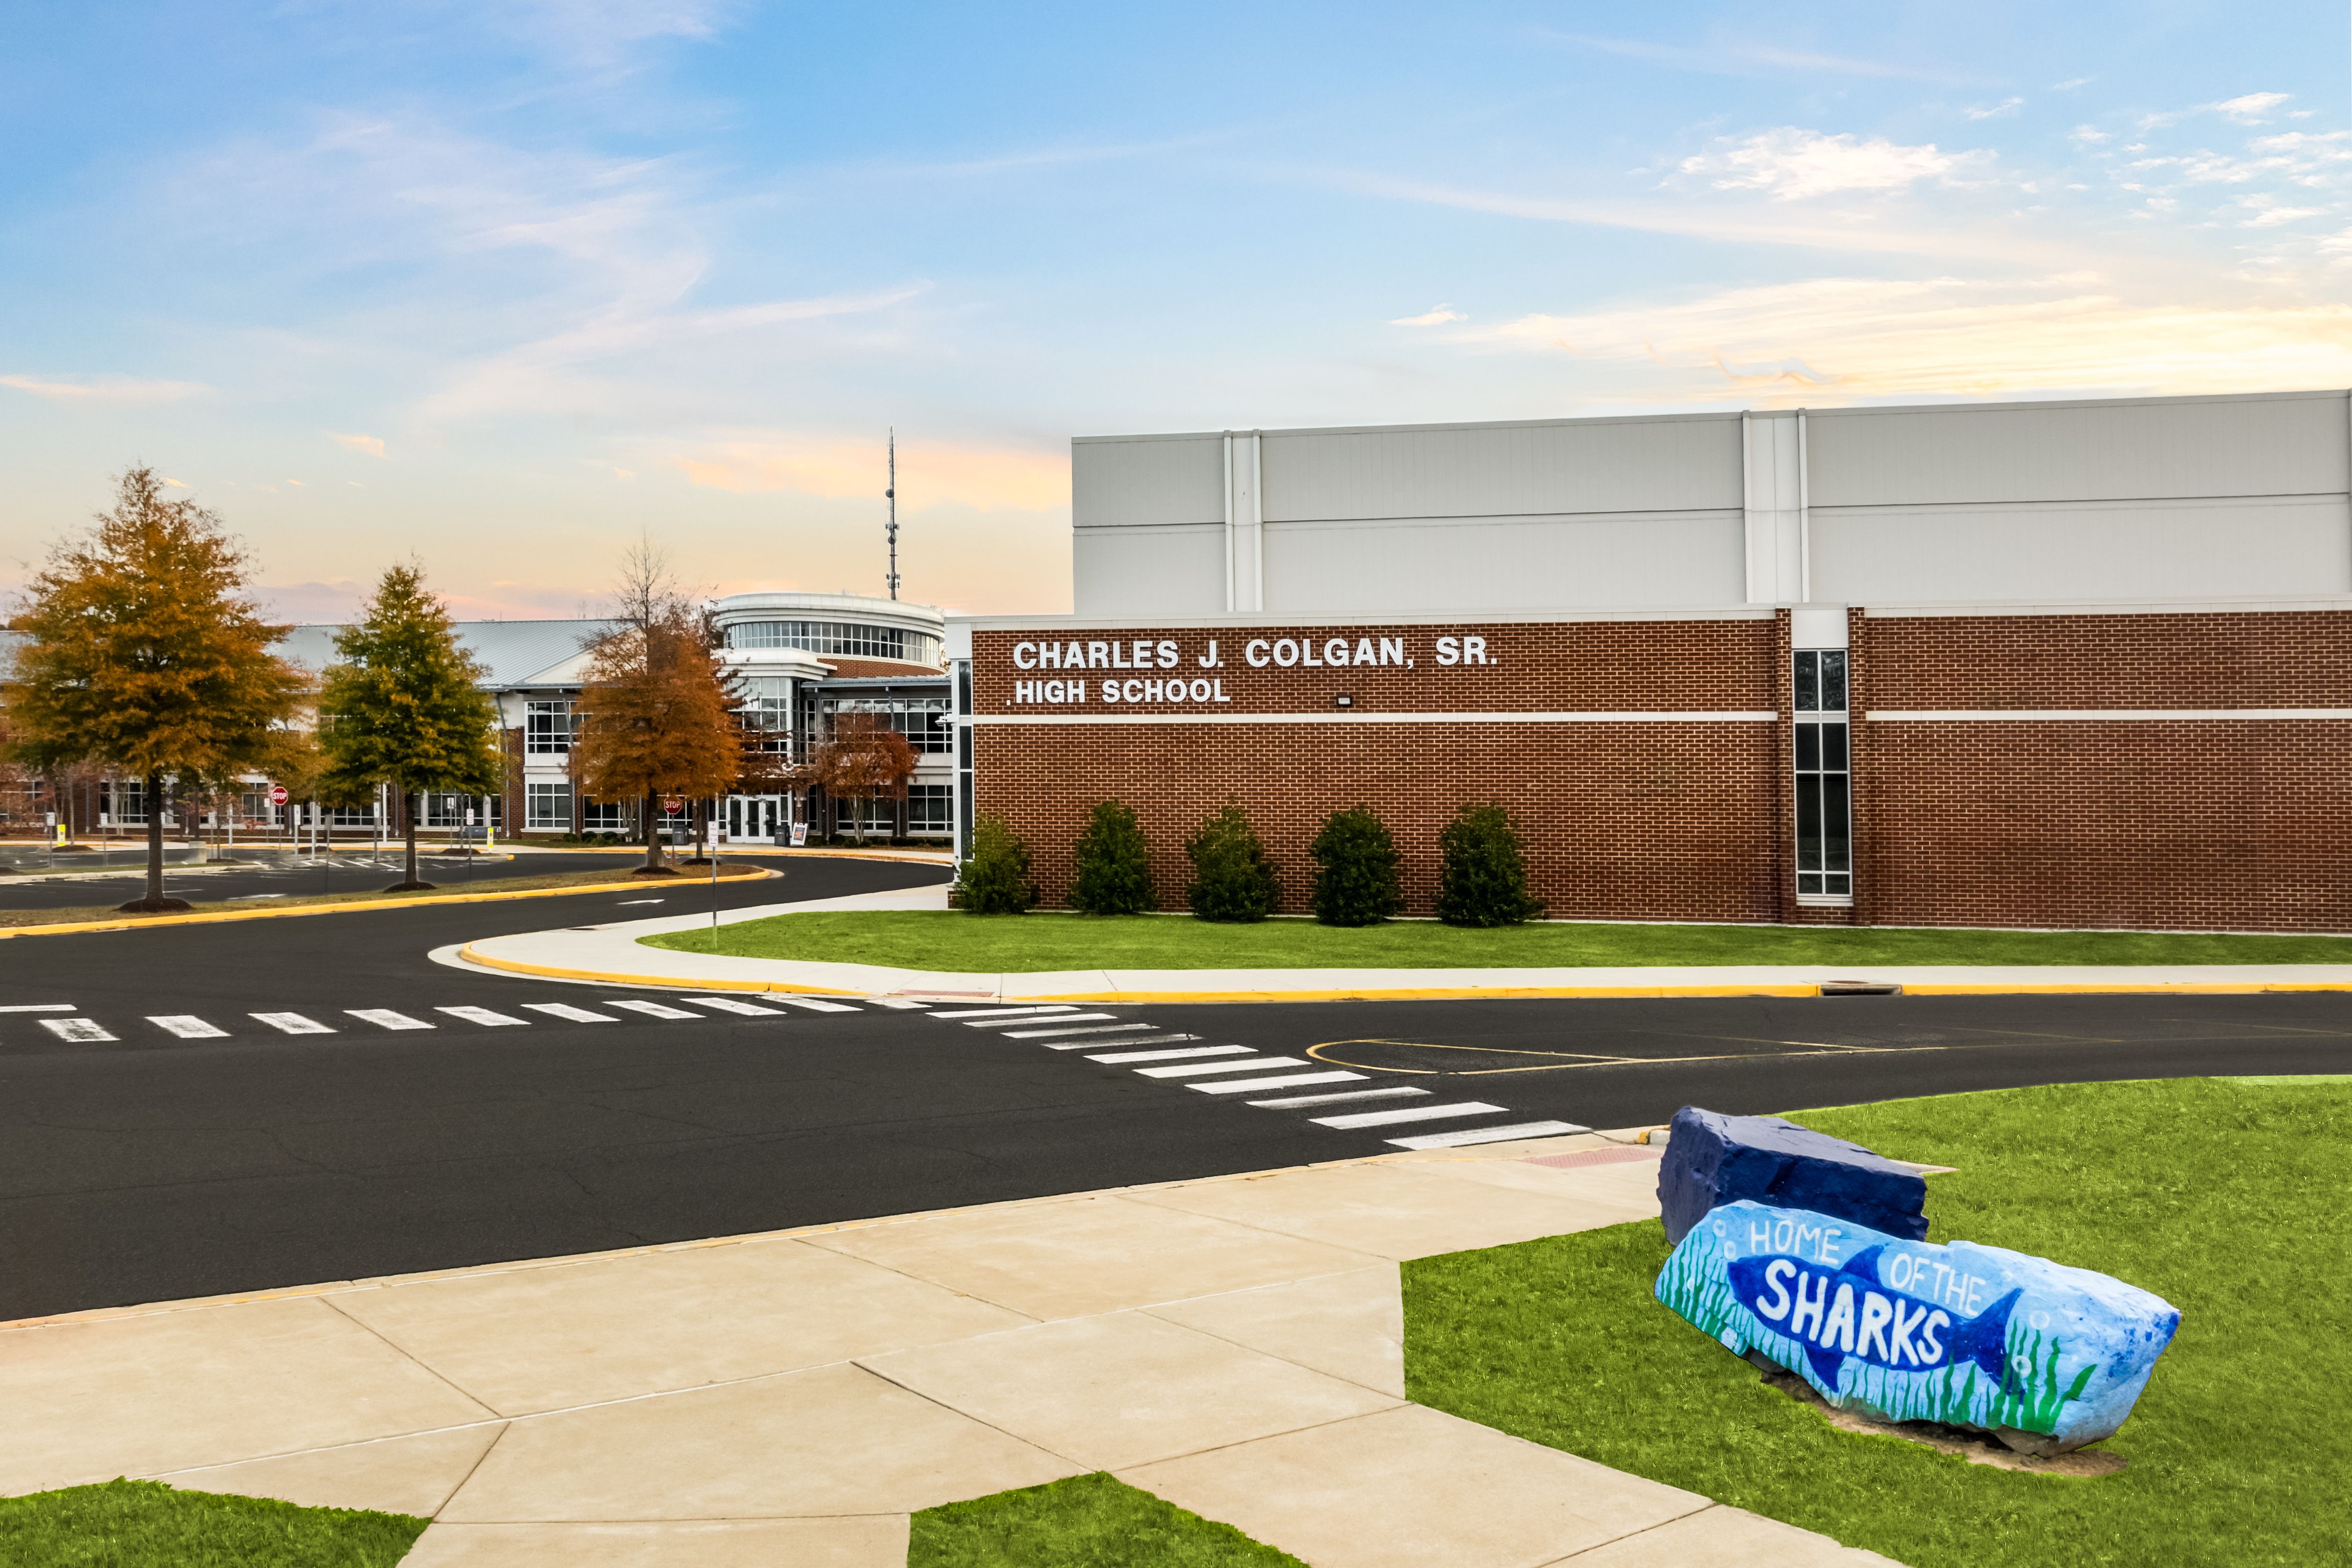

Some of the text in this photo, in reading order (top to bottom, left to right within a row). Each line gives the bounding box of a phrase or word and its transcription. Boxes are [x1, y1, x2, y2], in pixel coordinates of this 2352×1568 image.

[1013, 636, 1497, 670] CHARLES J. COLGAN, SR.
[1016, 679, 1230, 703] HIGH SCHOOL
[1751, 1220, 1841, 1264] HOME
[1756, 1259, 1950, 1366] SHARKS
